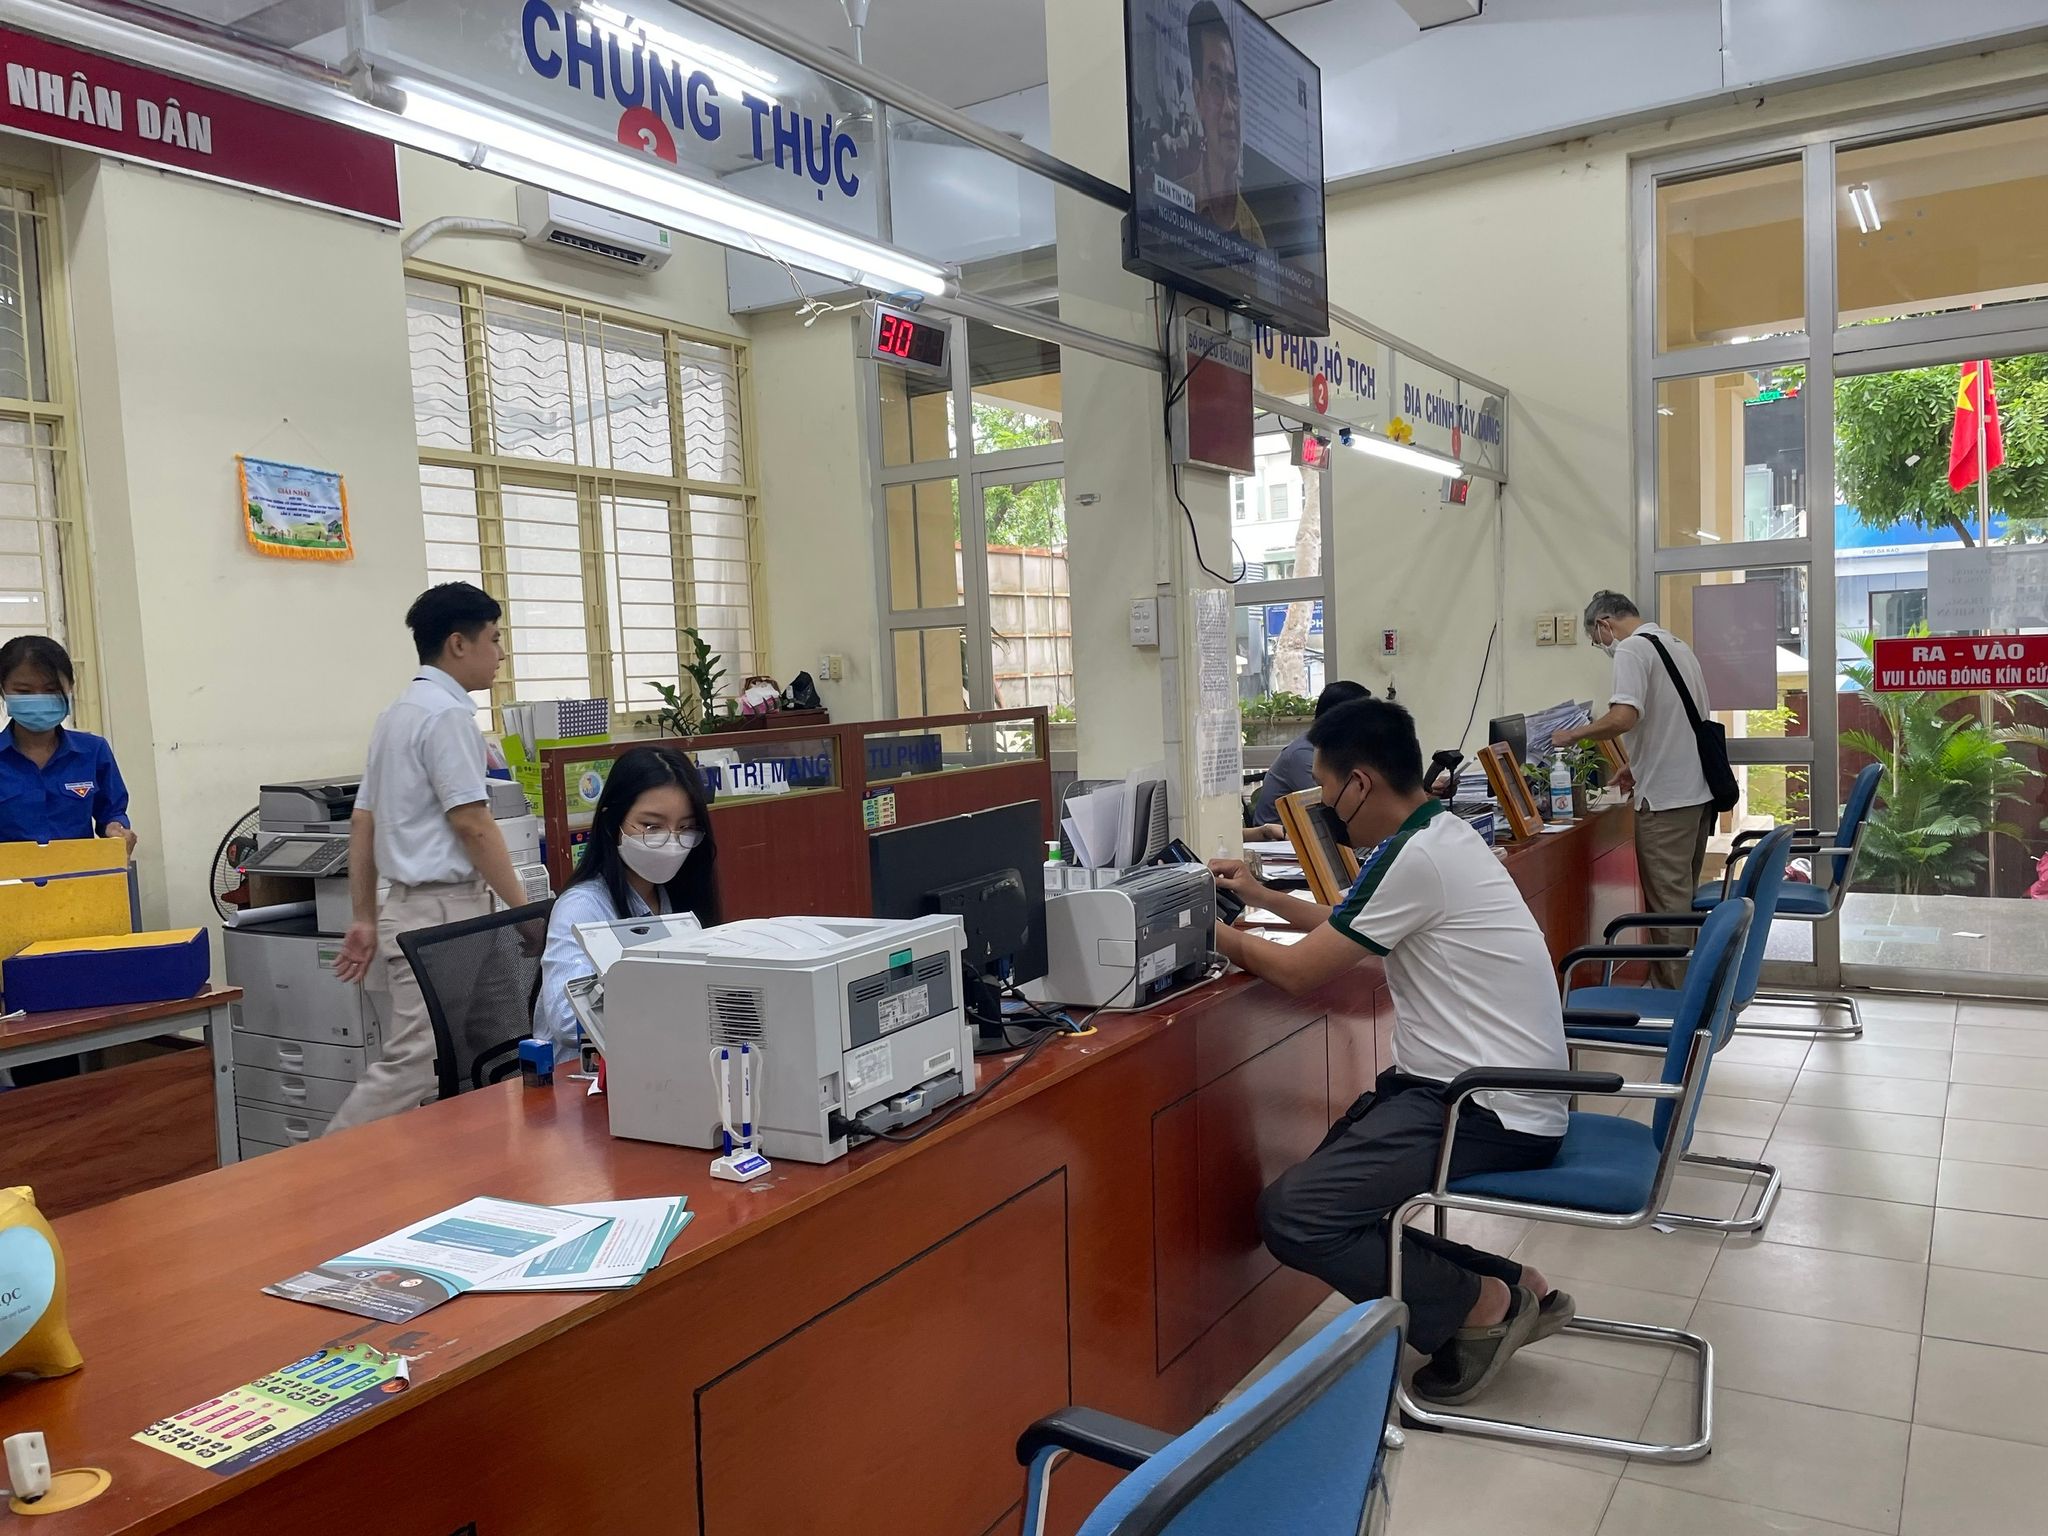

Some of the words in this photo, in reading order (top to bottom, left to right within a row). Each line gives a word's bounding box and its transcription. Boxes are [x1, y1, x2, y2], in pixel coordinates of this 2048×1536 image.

[6, 63, 123, 132] NHÂN
[136, 97, 213, 155] DÂN
[522, 0, 721, 141] CHỨNG
[742, 90, 860, 200] THỰC
[878, 315, 914, 357] 30
[1324, 341, 1342, 395] HỘ
[1347, 357, 1375, 401] TỊCH
[1318, 383, 1325, 405] 2
[1404, 382, 1422, 423] ĐỊA
[1425, 389, 1455, 430] CHÍNH
[1912, 646, 1946, 662] RA
[1972, 641, 2025, 660] VÀO
[1882, 669, 1904, 686] VUI
[1909, 666, 1946, 685] LÒNG
[1951, 665, 1990, 684] ĐÓNG
[1996, 664, 2021, 683] KÍN
[729, 761, 764, 790] TRỊ
